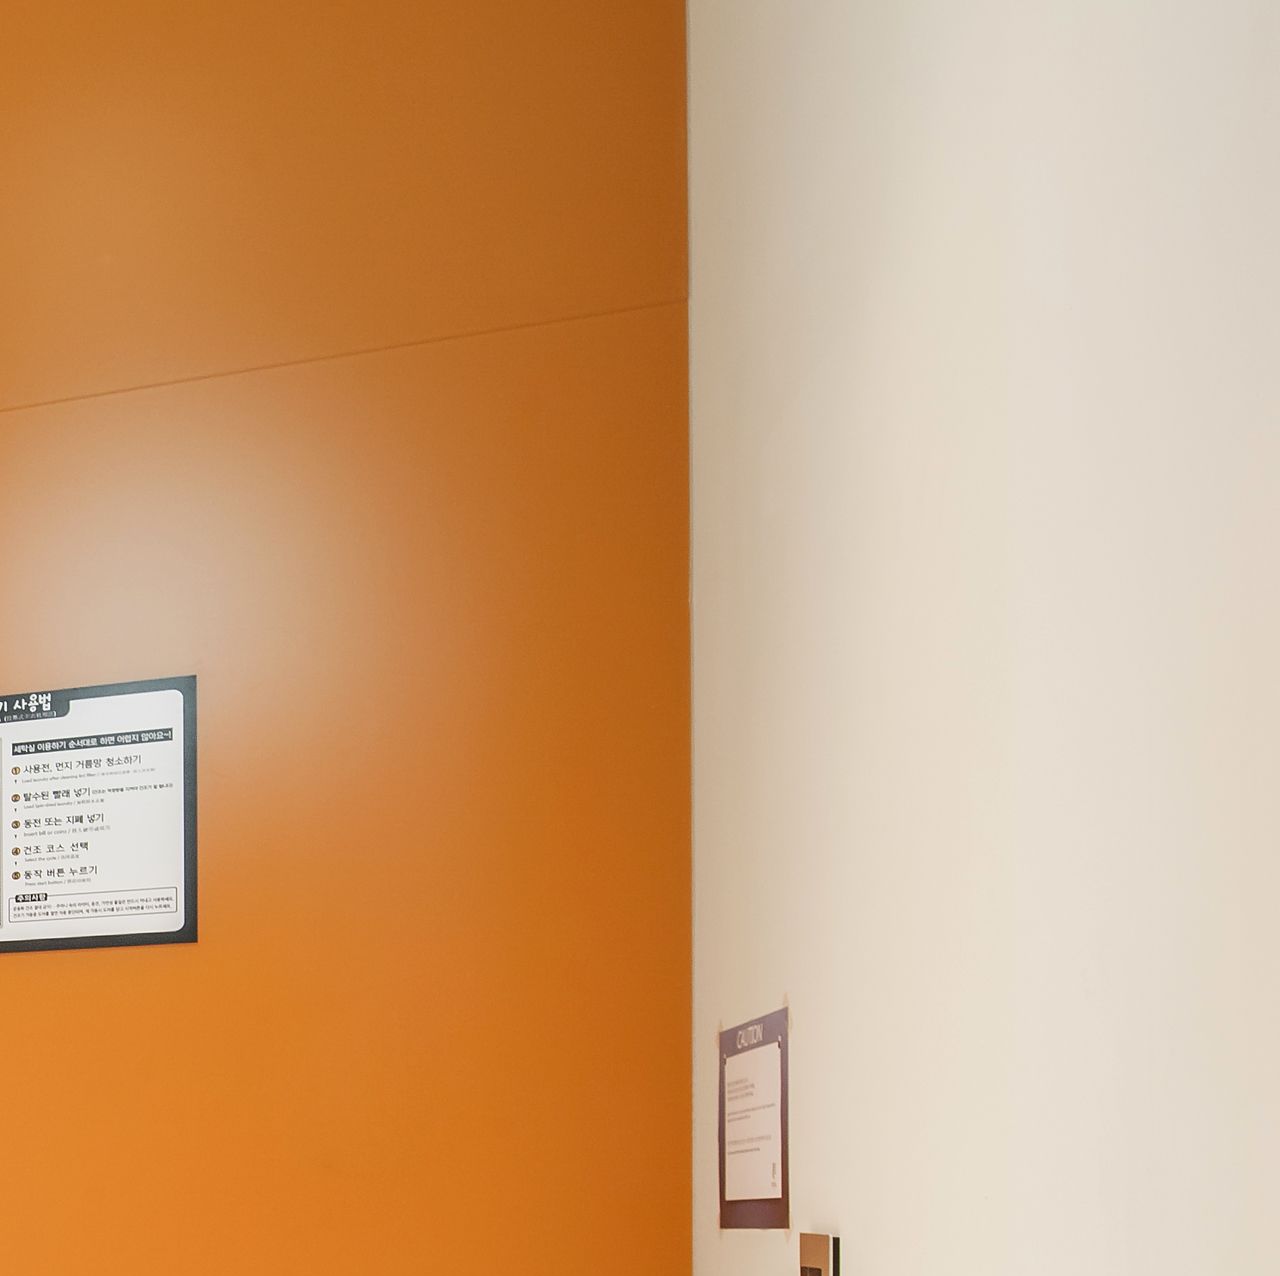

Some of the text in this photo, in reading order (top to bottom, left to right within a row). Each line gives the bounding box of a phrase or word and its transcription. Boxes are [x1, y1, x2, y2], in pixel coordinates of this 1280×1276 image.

[13, 692, 51, 712] 사용법
[100, 735, 115, 746] 하면
[55, 760, 72, 771] 먼지
[75, 758, 102, 769] 거름망
[106, 754, 141, 766] 청소하기
[23, 791, 49, 802] 탈수된
[53, 788, 70, 799] 빨래
[73, 786, 90, 798] 넣기
[24, 813, 104, 829] 동전 또는 지폐 넣기
[24, 841, 88, 855] 건조 코스 선택
[24, 865, 97, 880] 동작 버튼 누르기
[736, 1023, 764, 1048] CAUTION
